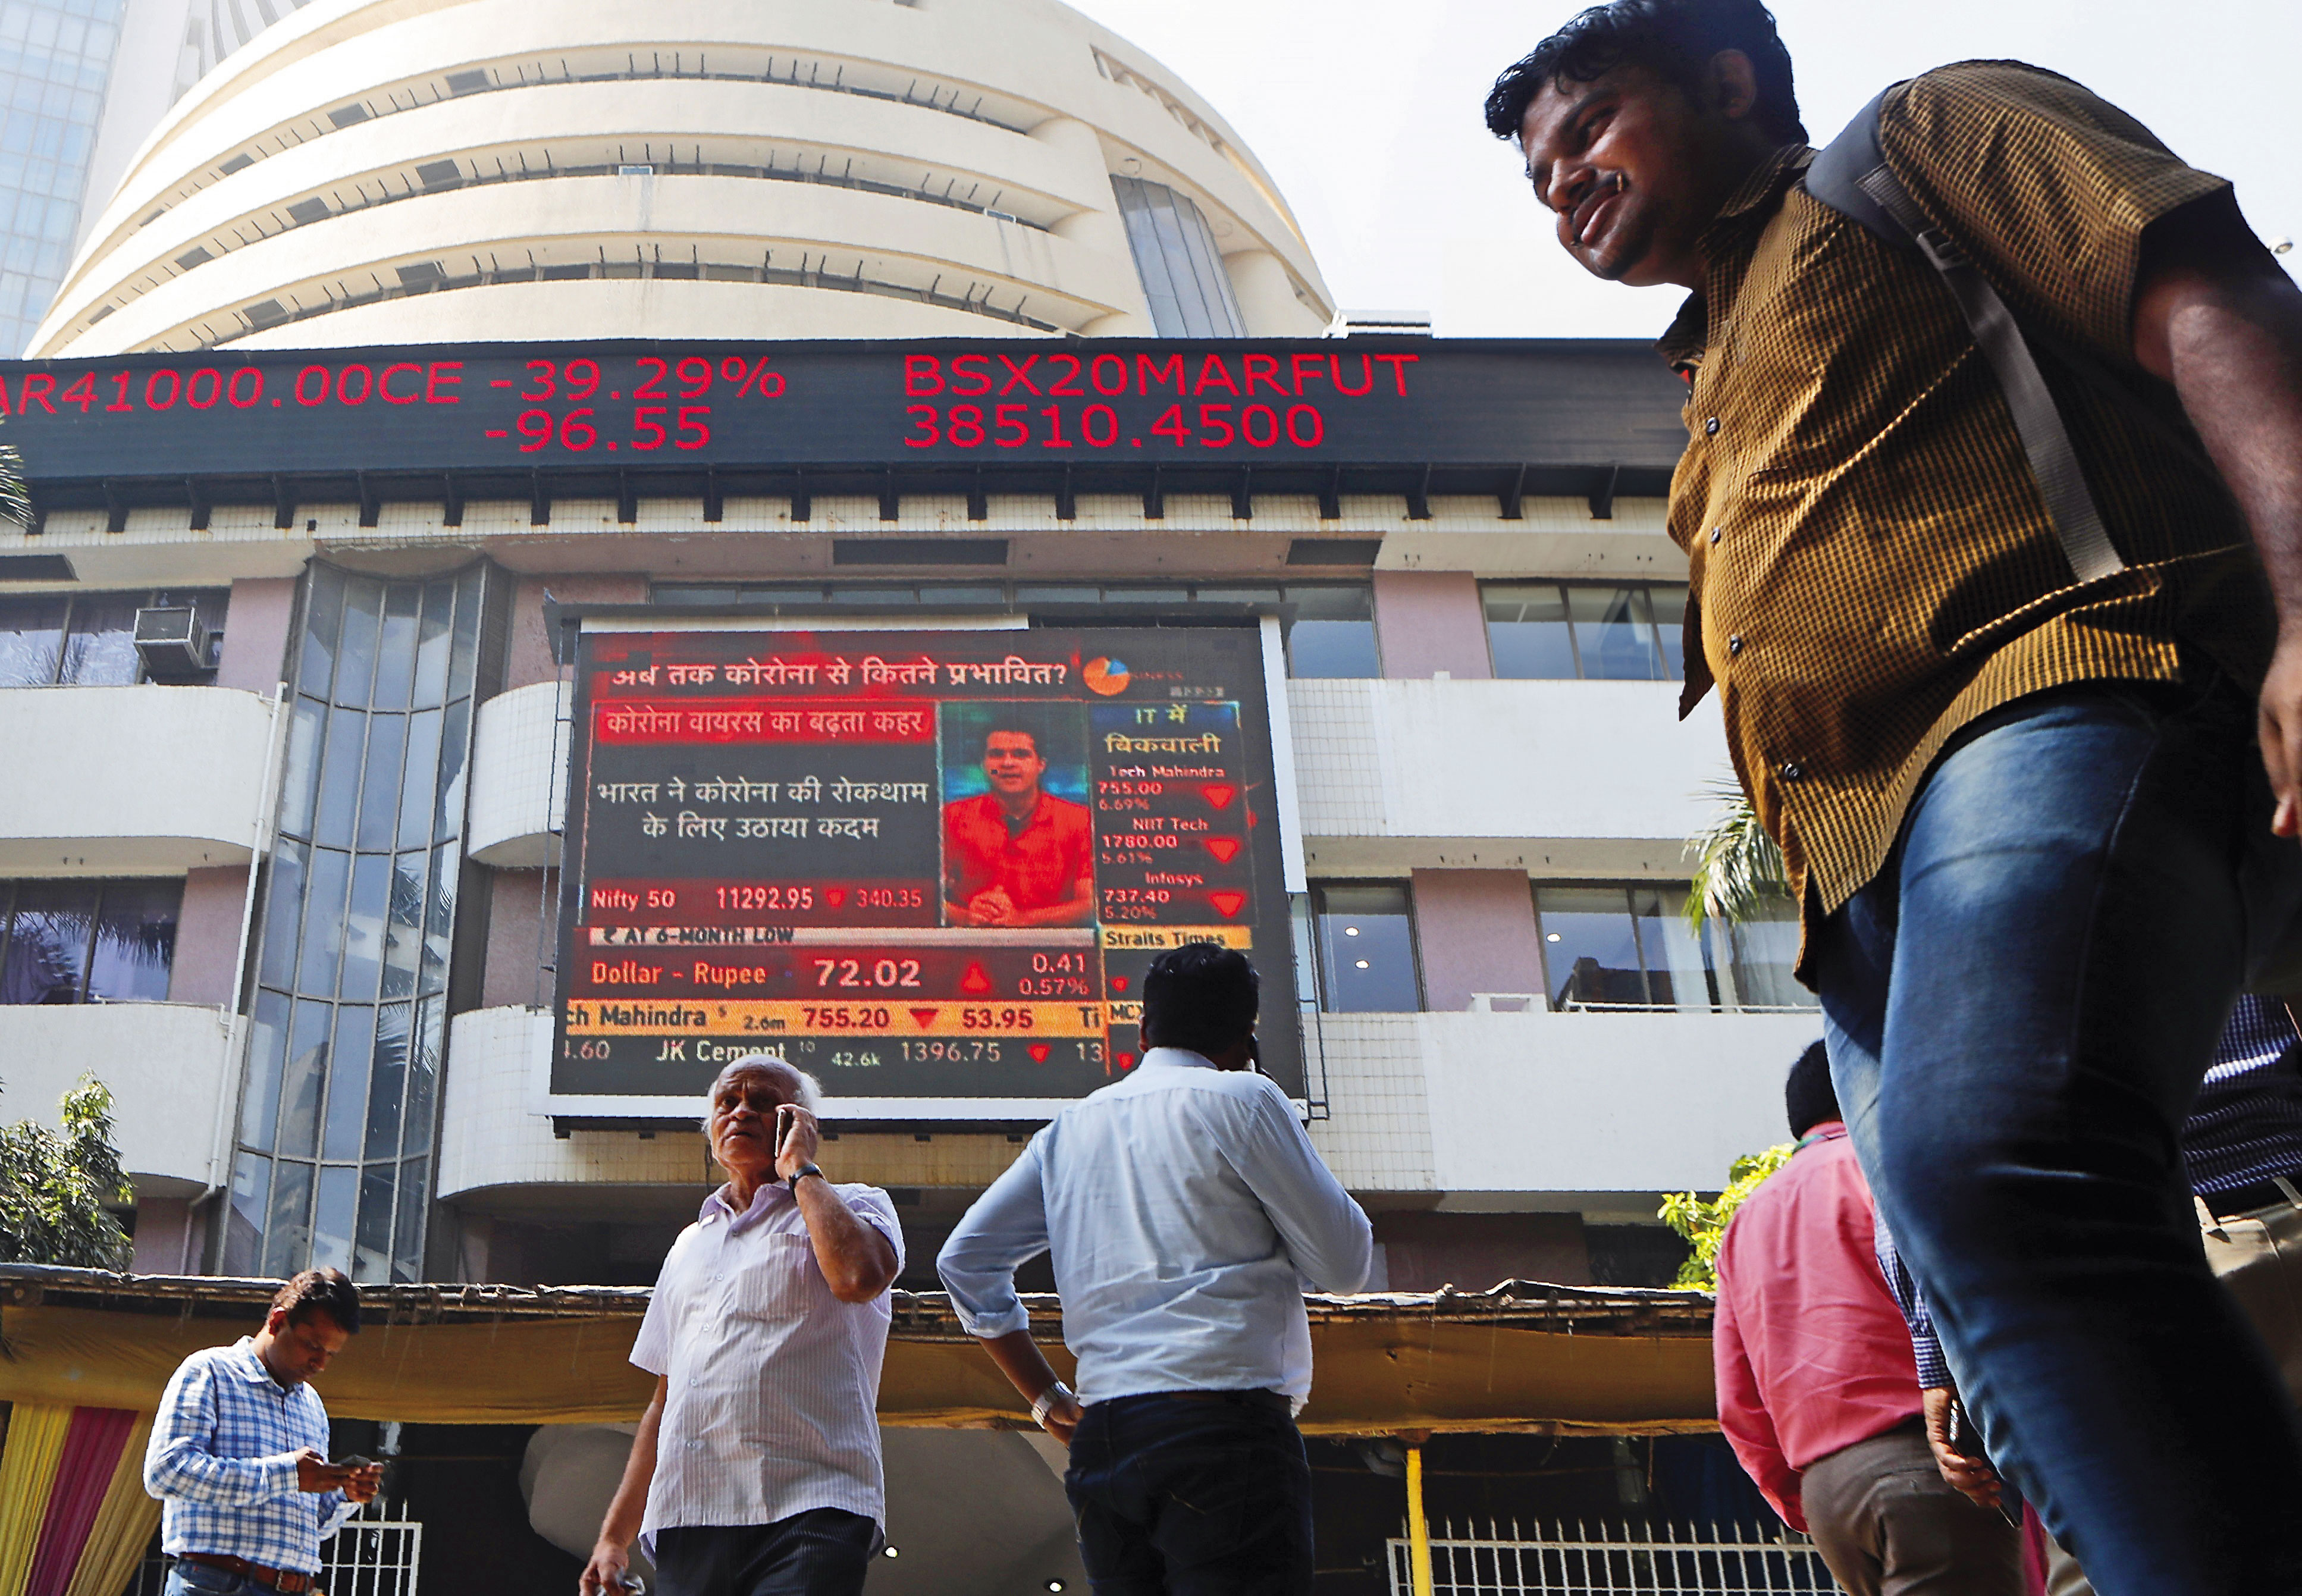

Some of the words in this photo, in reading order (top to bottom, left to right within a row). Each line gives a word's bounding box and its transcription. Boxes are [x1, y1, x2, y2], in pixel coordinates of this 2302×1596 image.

[490, 356, 786, 401] -39.29%
[904, 353, 1420, 397] BSX20MARFUT
[485, 406, 711, 451] -96.55
[904, 403, 1325, 447] 38510.4500
[613, 665, 660, 685] अब
[667, 664, 717, 685] तक
[724, 657, 818, 685] कोरोना
[825, 657, 852, 685] से
[860, 656, 939, 685] कितने
[946, 655, 1067, 685] प्रभावित?
[607, 704, 683, 733] कोरोना
[688, 711, 764, 733] वायरस
[770, 711, 803, 732] का
[807, 711, 866, 738] बढ़ता
[872, 711, 923, 735] कहर
[1136, 708, 1158, 725] IT
[1152, 764, 1226, 777] Mahindra
[597, 783, 660, 803] भारत
[667, 776, 686, 803] ने
[695, 776, 779, 803] कोरोना
[787, 775, 823, 803] की
[830, 776, 929, 803] रोकथाम
[1098, 781, 1163, 795] 755.00
[642, 810, 669, 838] के
[677, 810, 728, 841] लिए
[735, 818, 808, 838] उठाया
[817, 818, 880, 840] कदम
[1133, 817, 1165, 831] NIIT
[1169, 817, 1209, 831] Tech
[1145, 871, 1204, 888] Infosys
[592, 889, 640, 913] Nifty
[647, 889, 676, 909] 50
[716, 886, 814, 910] 11292.95
[857, 888, 923, 908] 340.35
[1104, 889, 1171, 904] 737.40
[1106, 932, 1166, 946] Straits
[592, 960, 663, 984] Dollar
[694, 960, 767, 990] Rupee
[813, 959, 921, 987] 72.02
[1033, 952, 1085, 973] 0.41
[1019, 977, 1090, 996] 0.57%
[600, 1005, 706, 1026] Mahindra
[803, 1007, 890, 1028] 755.20
[962, 1008, 1033, 1029] 53.95
[1078, 1006, 1100, 1028] Ti
[656, 1039, 686, 1061] JK
[901, 1042, 1002, 1062] 1396.75
[1075, 1042, 1103, 1062] 13
